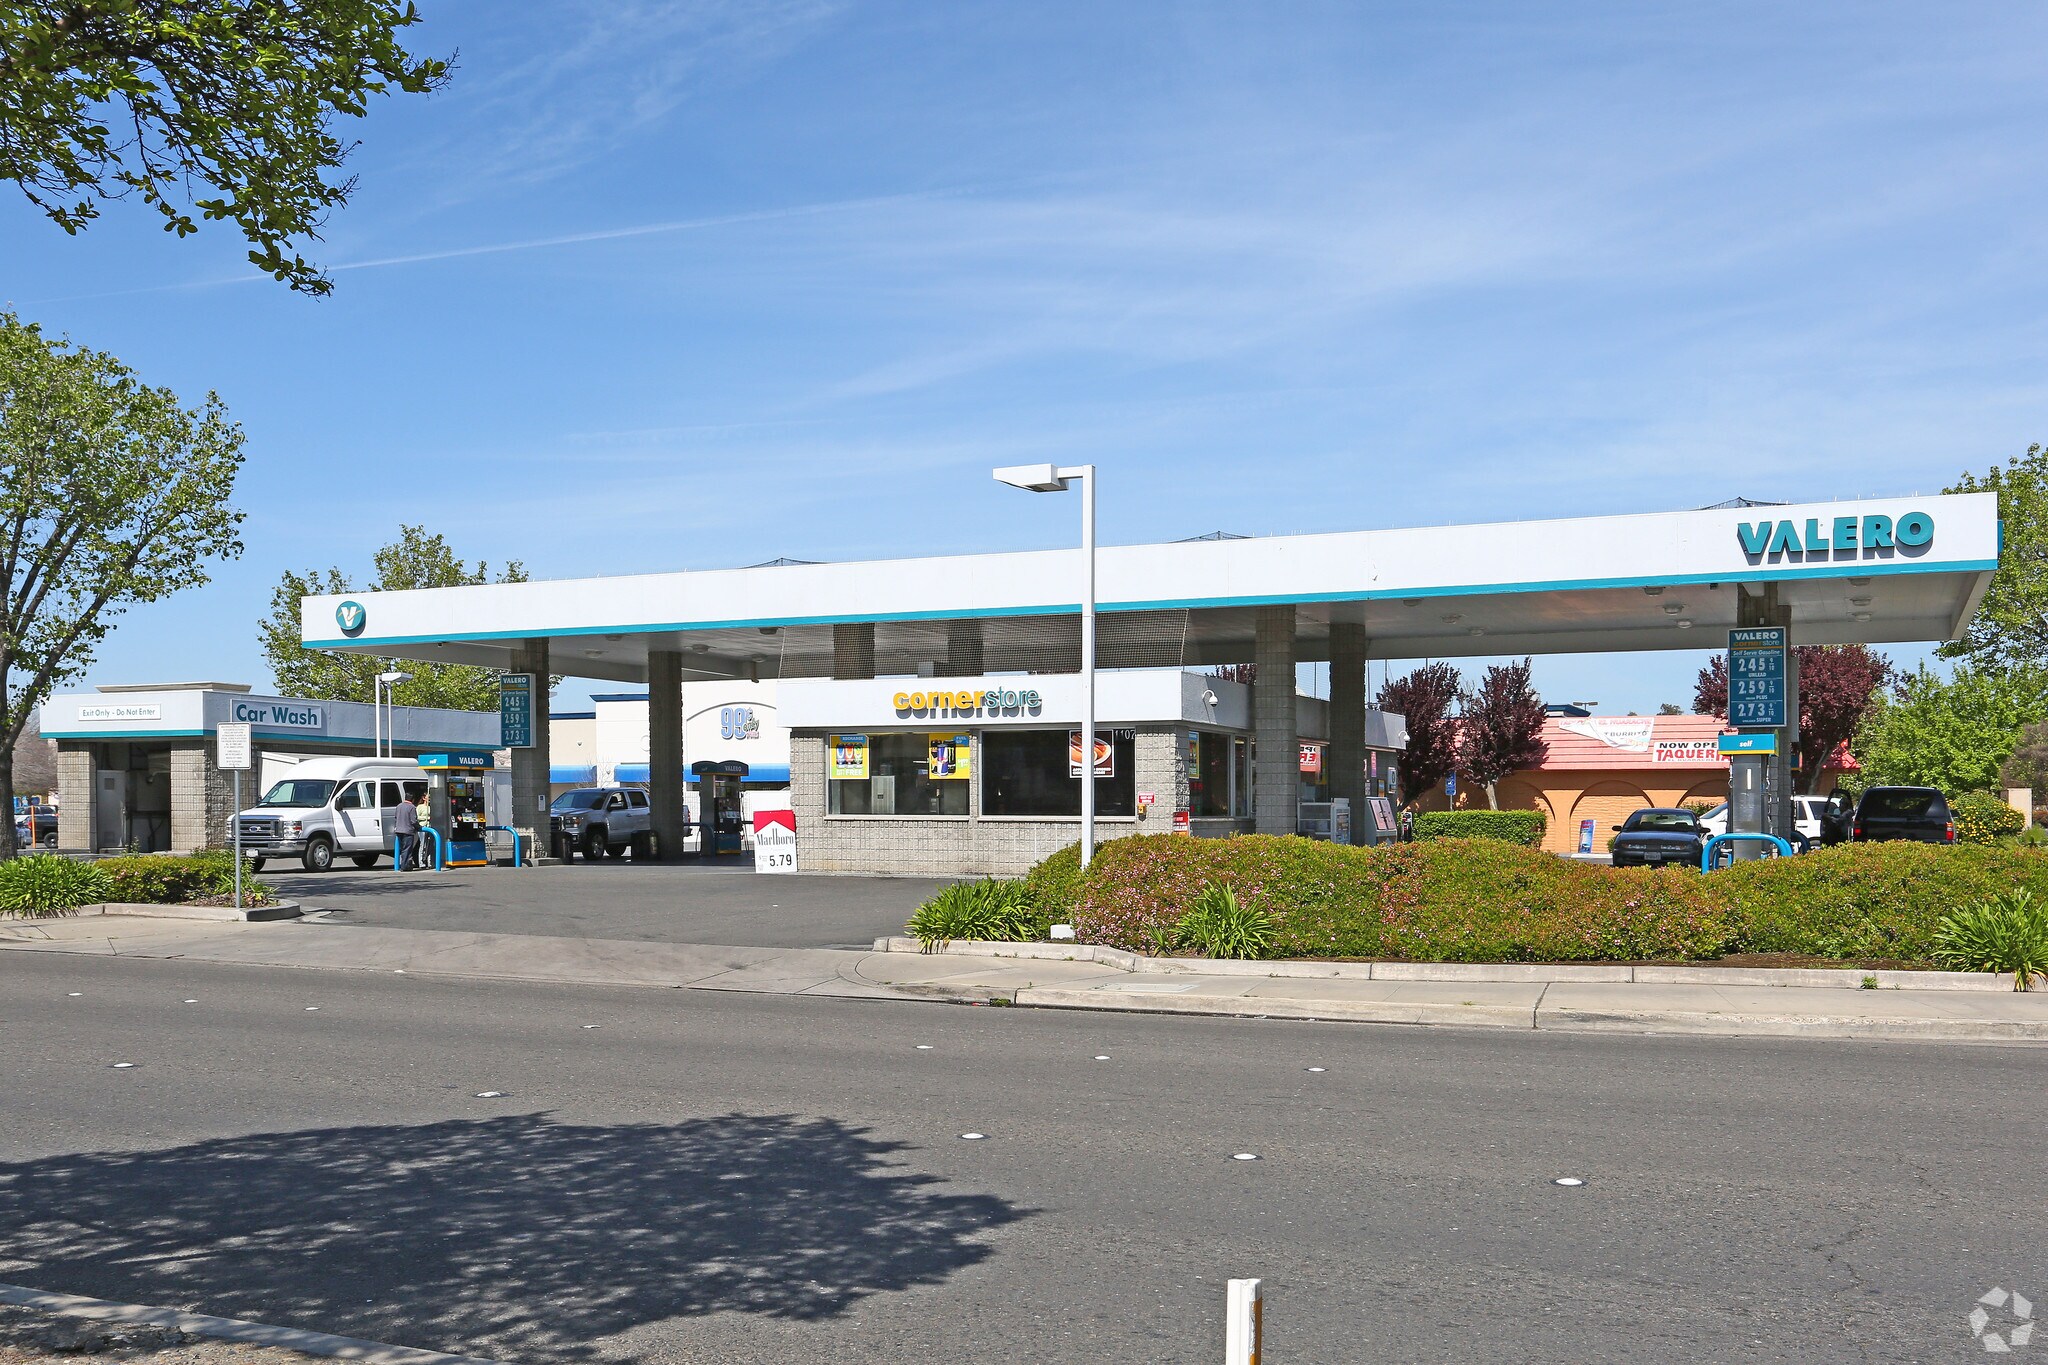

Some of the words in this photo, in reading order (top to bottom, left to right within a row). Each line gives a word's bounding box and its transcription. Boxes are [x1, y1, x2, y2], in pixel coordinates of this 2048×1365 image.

[1737, 511, 1935, 556] VALERO
[1734, 631, 1779, 640] VALERO
[1738, 658, 1765, 672] 2.45
[1738, 681, 1765, 694] 2.59
[82, 709, 94, 717] Exit
[95, 709, 110, 718] Only
[116, 708, 125, 716] Do
[126, 708, 138, 716] Not
[139, 707, 156, 716] Enter
[236, 703, 267, 722] Car
[271, 706, 318, 725] Wash
[1738, 703, 1765, 716] 2.73
[1739, 740, 1753, 748] self
[459, 756, 484, 765] VALERO
[756, 827, 794, 846] Marlboro
[769, 853, 792, 867] 5.79
